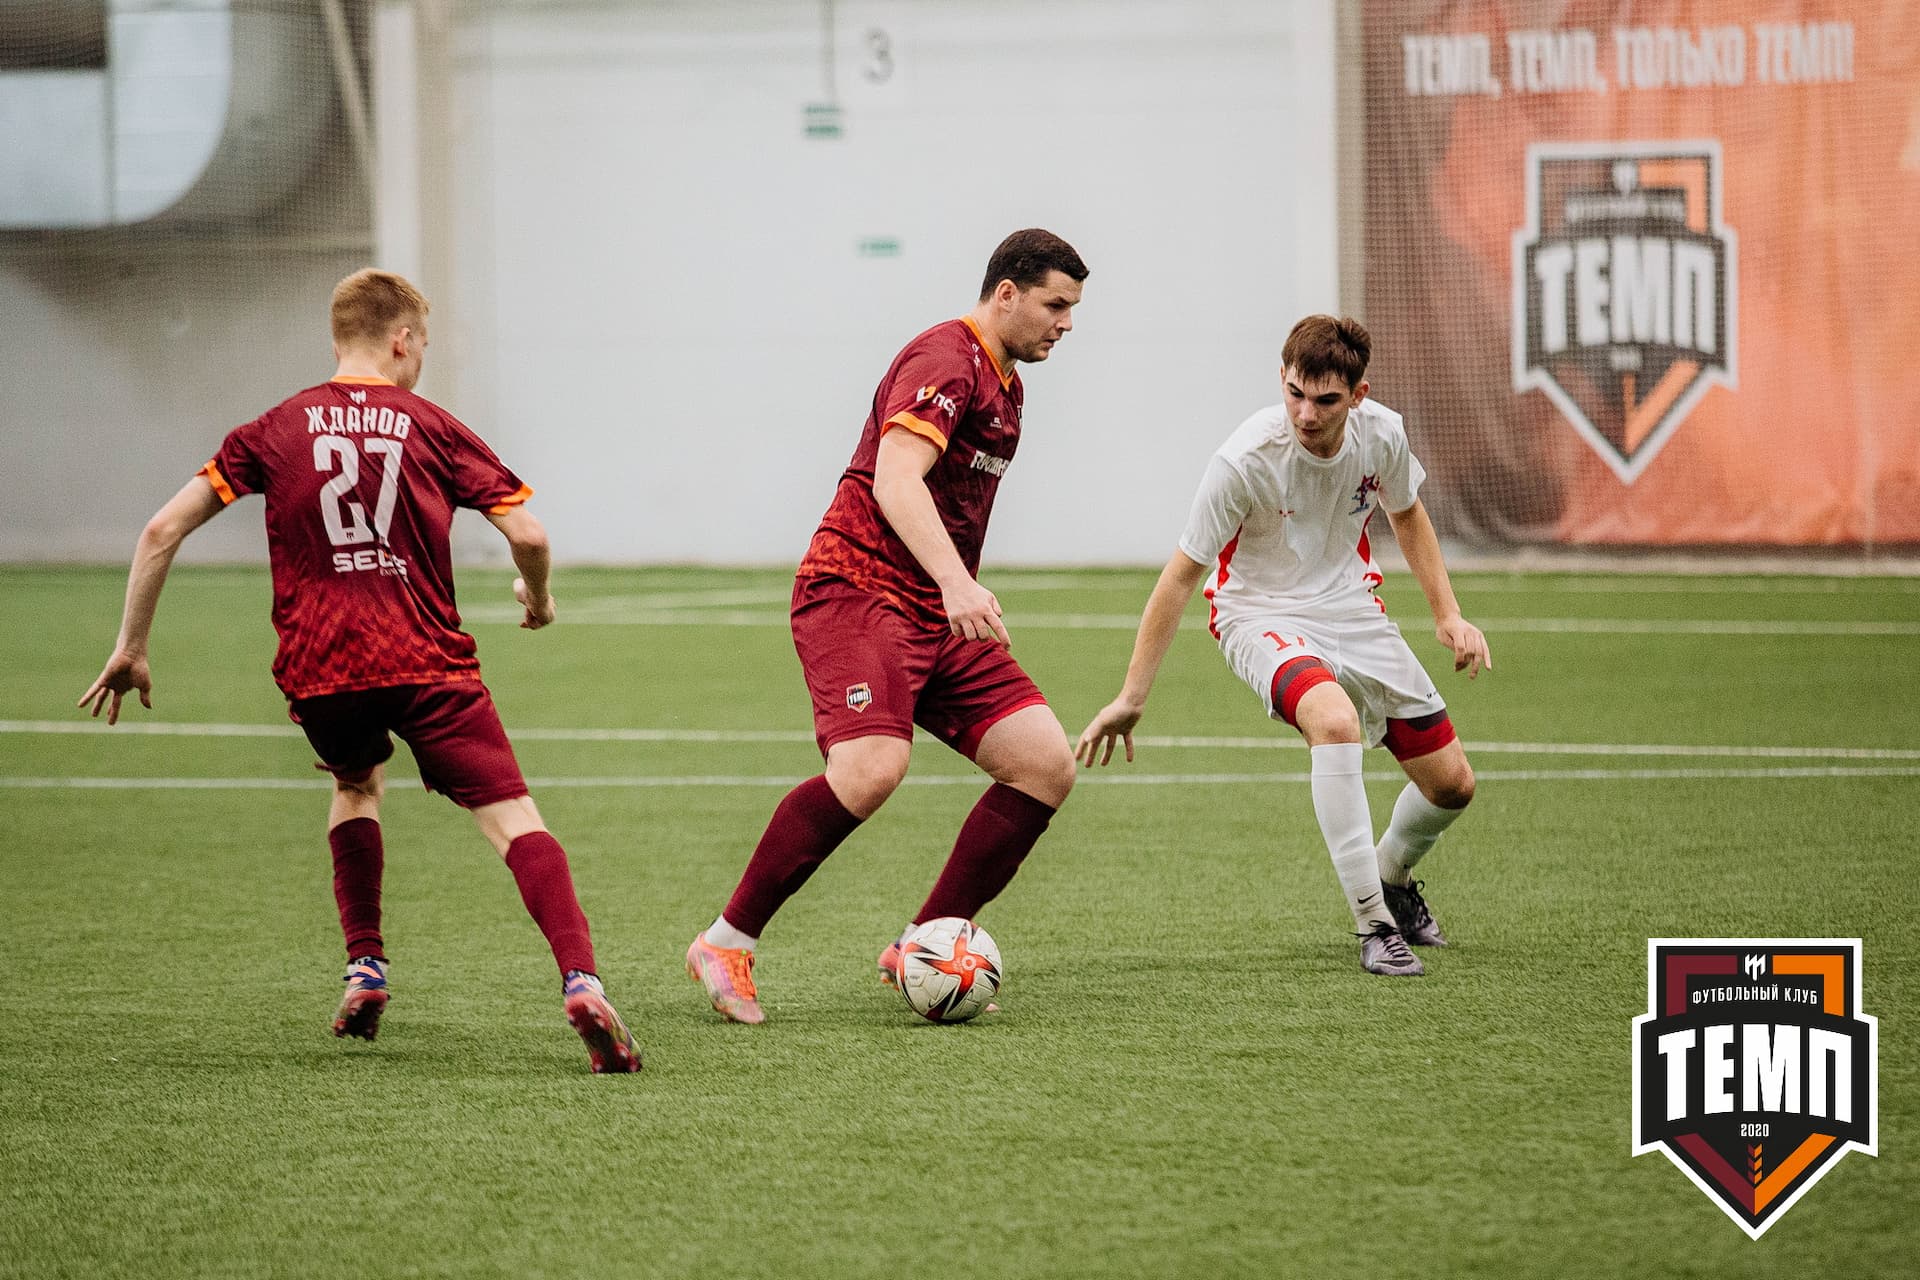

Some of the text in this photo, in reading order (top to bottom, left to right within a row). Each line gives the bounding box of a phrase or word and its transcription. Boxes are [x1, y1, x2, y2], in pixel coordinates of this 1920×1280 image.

[864, 28, 894, 84] 3
[1616, 26, 1745, 88] ТОЛЬКО
[1535, 236, 1717, 355] ТЕМП
[304, 405, 412, 440] ЖДАНОВ
[313, 434, 403, 547] 27
